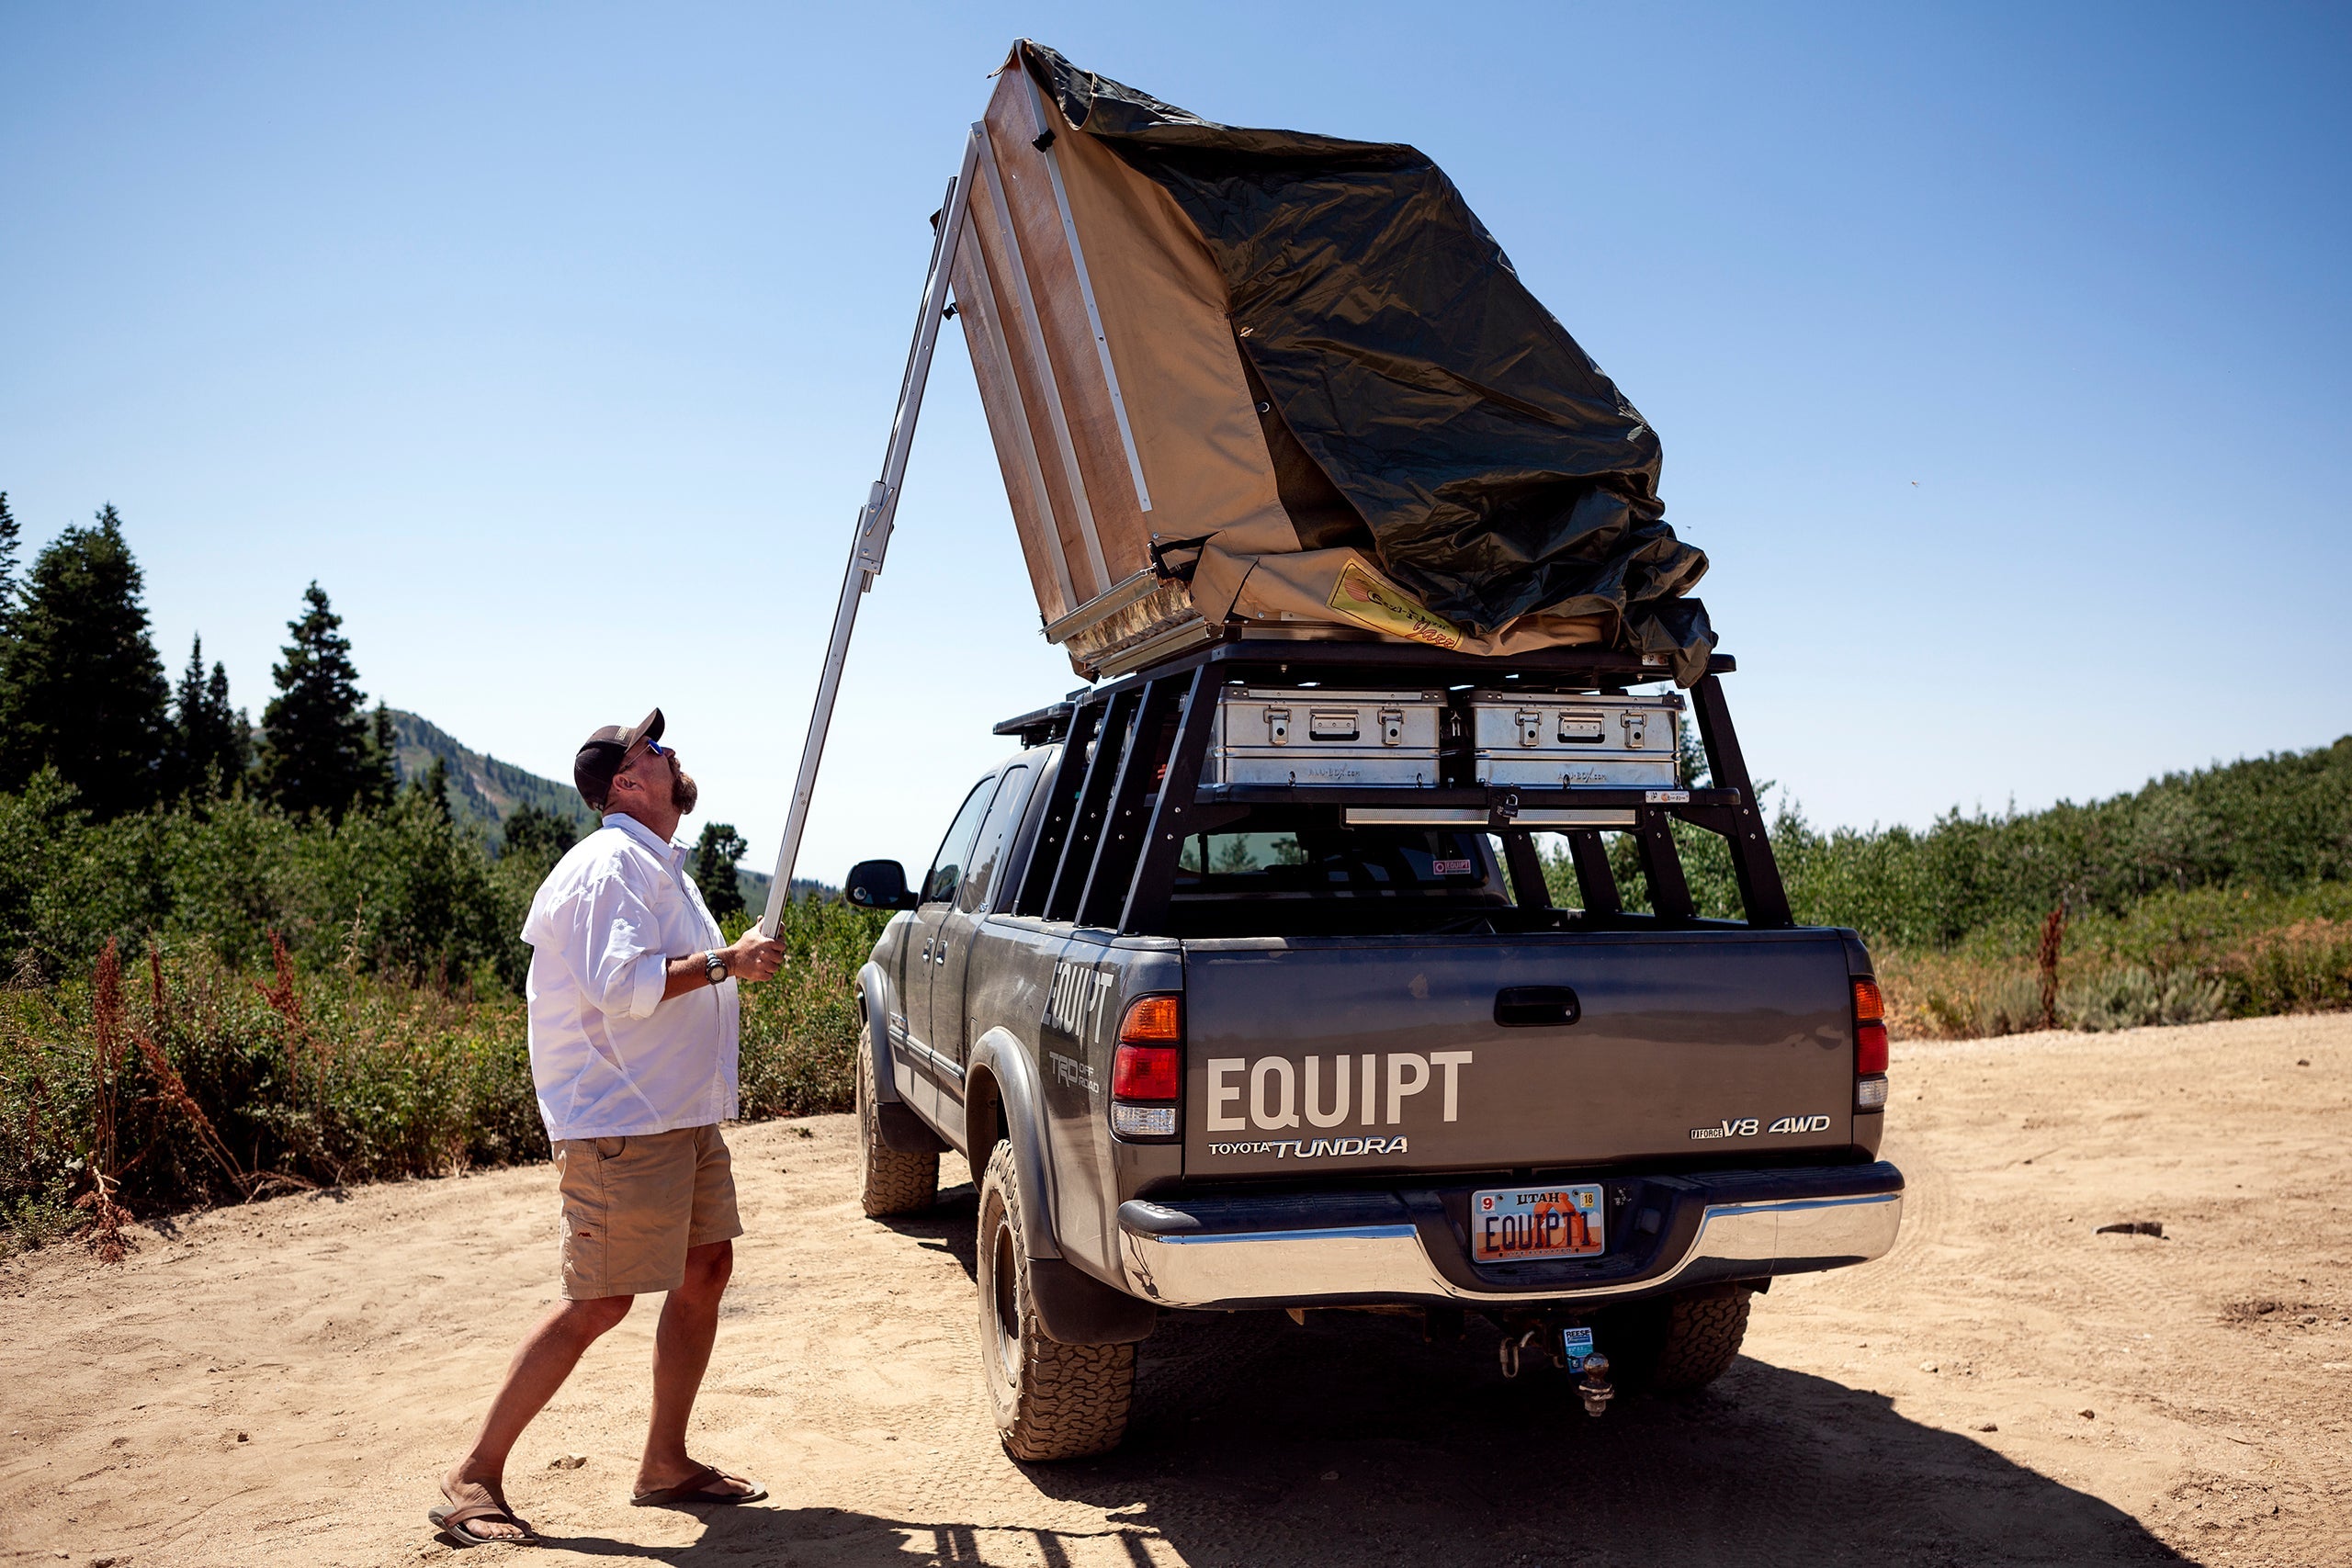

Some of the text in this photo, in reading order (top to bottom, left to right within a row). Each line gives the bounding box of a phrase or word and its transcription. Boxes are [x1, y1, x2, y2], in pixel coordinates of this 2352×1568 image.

[1041, 961, 1114, 1043] EQUIPT
[1049, 1051, 1079, 1088] TRD
[1079, 1062, 1094, 1077] OFF
[1078, 1076, 1100, 1094] ROAD
[1206, 1051, 1473, 1133] EQUIPT
[1721, 1118, 1760, 1138] V8
[1768, 1115, 1831, 1135] 4WD
[1208, 1134, 1408, 1159] TOYOTA TUNDRA
[1483, 1197, 1493, 1210] 9
[1516, 1191, 1560, 1206] UTAH
[1584, 1194, 1593, 1204] 18
[1485, 1211, 1591, 1252] EQUIPT1
[1566, 1330, 1591, 1338] REESE
